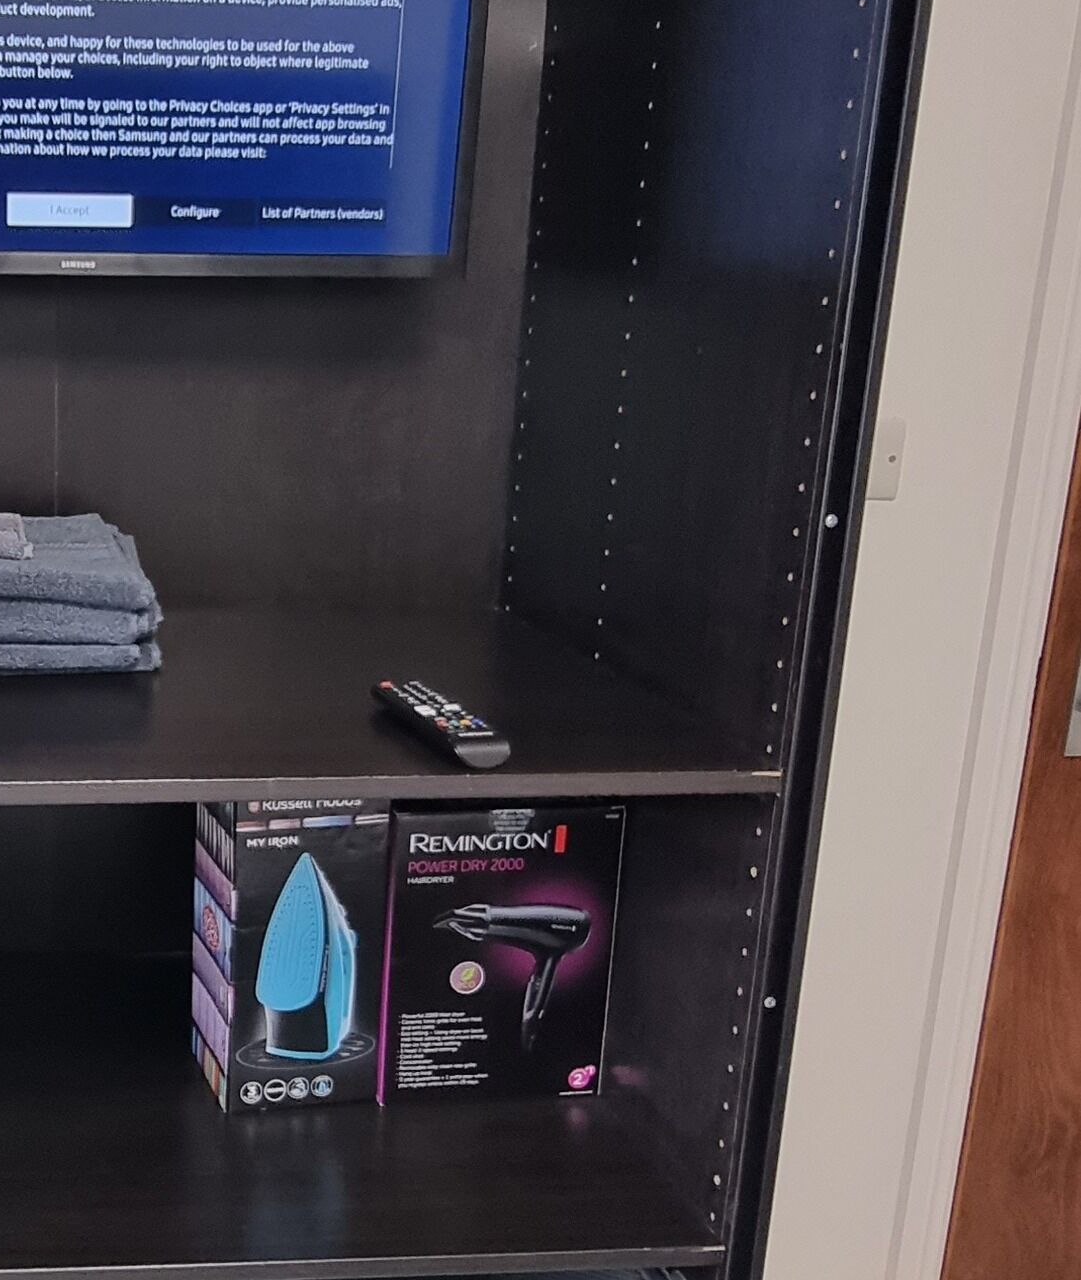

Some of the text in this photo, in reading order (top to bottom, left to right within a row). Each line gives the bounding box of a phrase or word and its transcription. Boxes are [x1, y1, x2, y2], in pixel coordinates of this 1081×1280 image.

[19, 1, 95, 20] development.
[6, 32, 44, 49] device,
[46, 33, 67, 47] and
[69, 33, 103, 52] happy
[105, 34, 121, 48] for
[123, 34, 153, 49] these
[155, 35, 225, 54] technologies
[226, 37, 239, 51] to
[240, 37, 254, 51] be
[256, 37, 282, 51] used
[283, 37, 300, 52] for
[301, 38, 321, 52] the
[321, 38, 355, 53] above
[37, 64, 74, 79] below.
[33, 141, 64, 155] about
[66, 141, 89, 156] how
[91, 144, 107, 156] we
[109, 145, 150, 160] process
[152, 145, 176, 160] your
[178, 143, 202, 157] data
[204, 144, 239, 161] please
[240, 144, 267, 158] visit:
[55, 202, 90, 218] Accept
[169, 203, 220, 220] Configure
[261, 205, 384, 222] List of Partners (vendors)
[246, 835, 299, 848] MY IRON
[409, 832, 548, 853] REMINGTON
[408, 858, 525, 873] POWER DRY 2000
